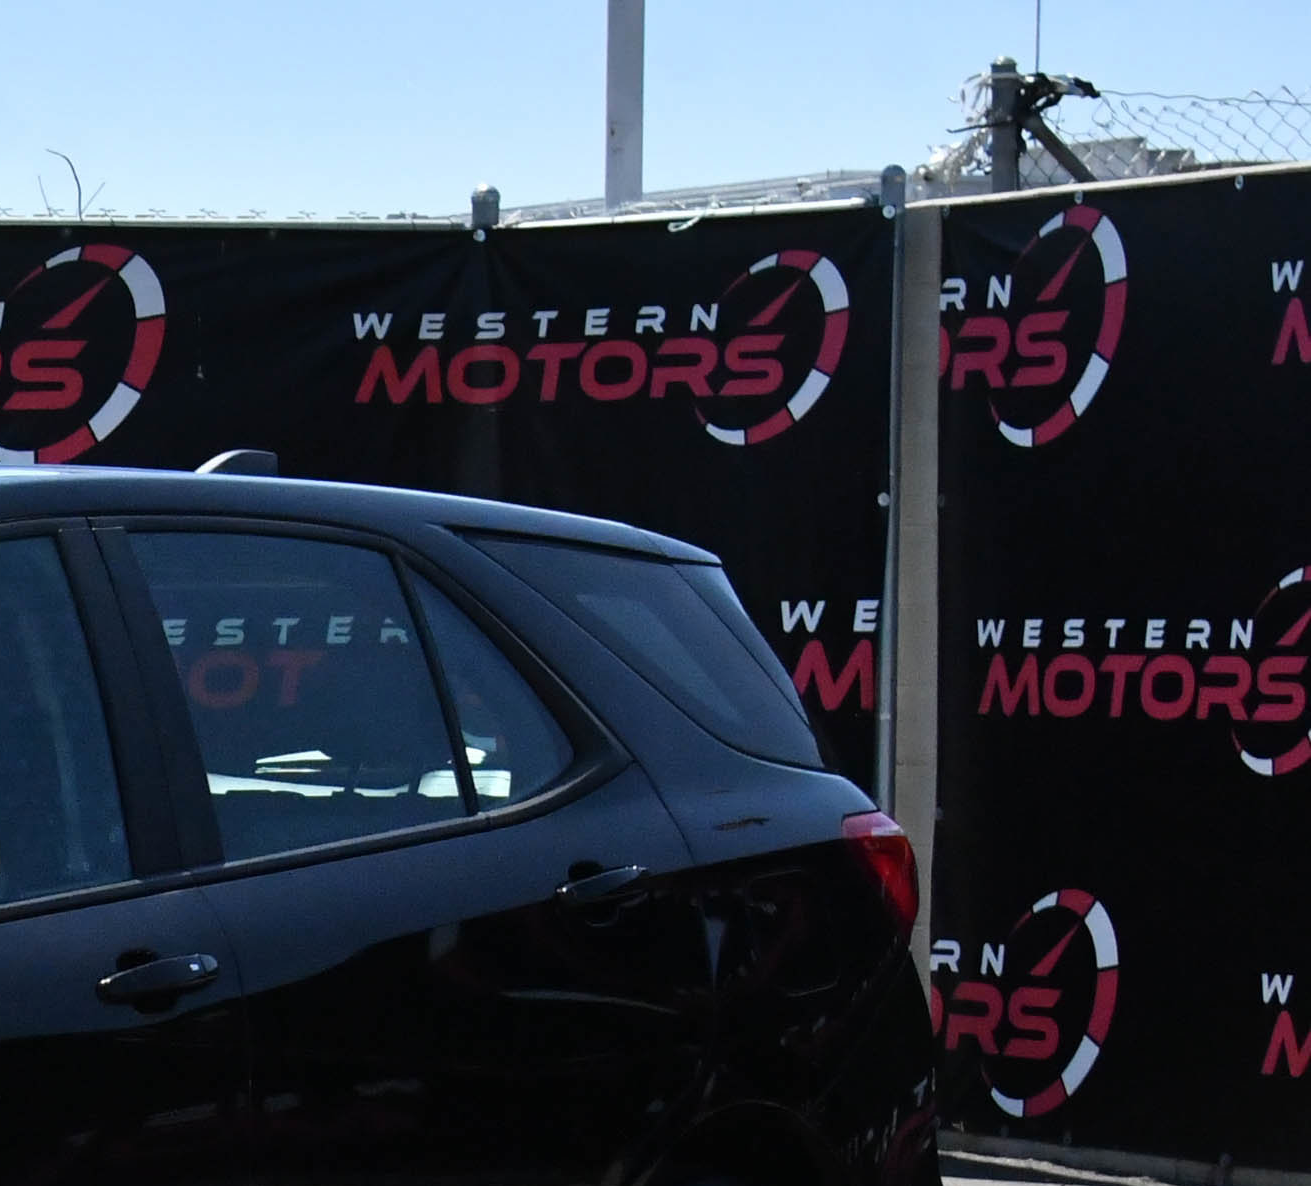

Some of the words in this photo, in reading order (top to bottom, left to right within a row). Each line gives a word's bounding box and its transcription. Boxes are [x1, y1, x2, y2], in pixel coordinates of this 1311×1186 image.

[353, 302, 718, 340] WESTERN
[940, 310, 1070, 390] RS
[354, 334, 786, 404] MOTORS
[977, 618, 1255, 650] WESTERN
[978, 653, 1311, 721] MOTORS
[931, 981, 1062, 1060] RS
